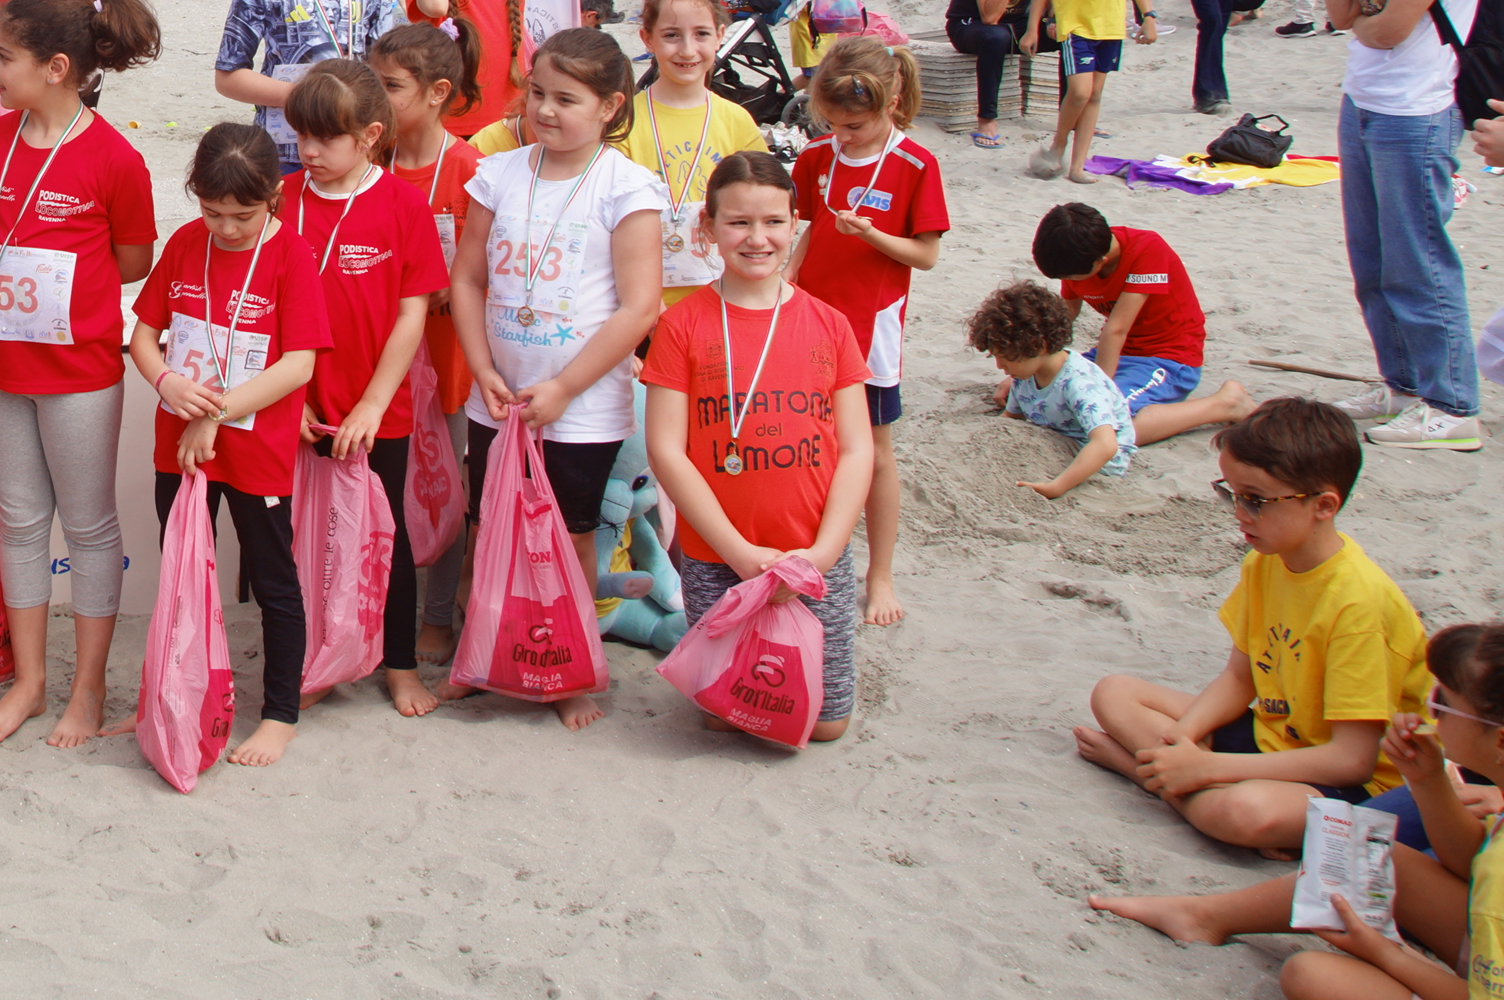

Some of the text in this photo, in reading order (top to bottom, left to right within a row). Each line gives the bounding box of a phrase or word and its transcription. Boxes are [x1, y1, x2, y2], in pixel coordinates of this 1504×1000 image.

[39, 189, 80, 205] PODISTICA
[34, 200, 95, 217] LOCOMOTIVA
[38, 214, 66, 223] RAVENNA
[337, 249, 393, 270] LOCOMOTIVA
[339, 244, 380, 256] PODISTICA
[494, 239, 563, 282] 253
[228, 315, 257, 325] RENNA
[493, 322, 553, 347] Starfish
[180, 348, 225, 395] 52
[697, 389, 833, 430] MARATONA
[755, 422, 782, 438] del
[322, 506, 339, 592] oltre le cose
[512, 643, 573, 668] Giro d'alia
[729, 676, 756, 704] Gro
[729, 707, 772, 726] MAGLIA
